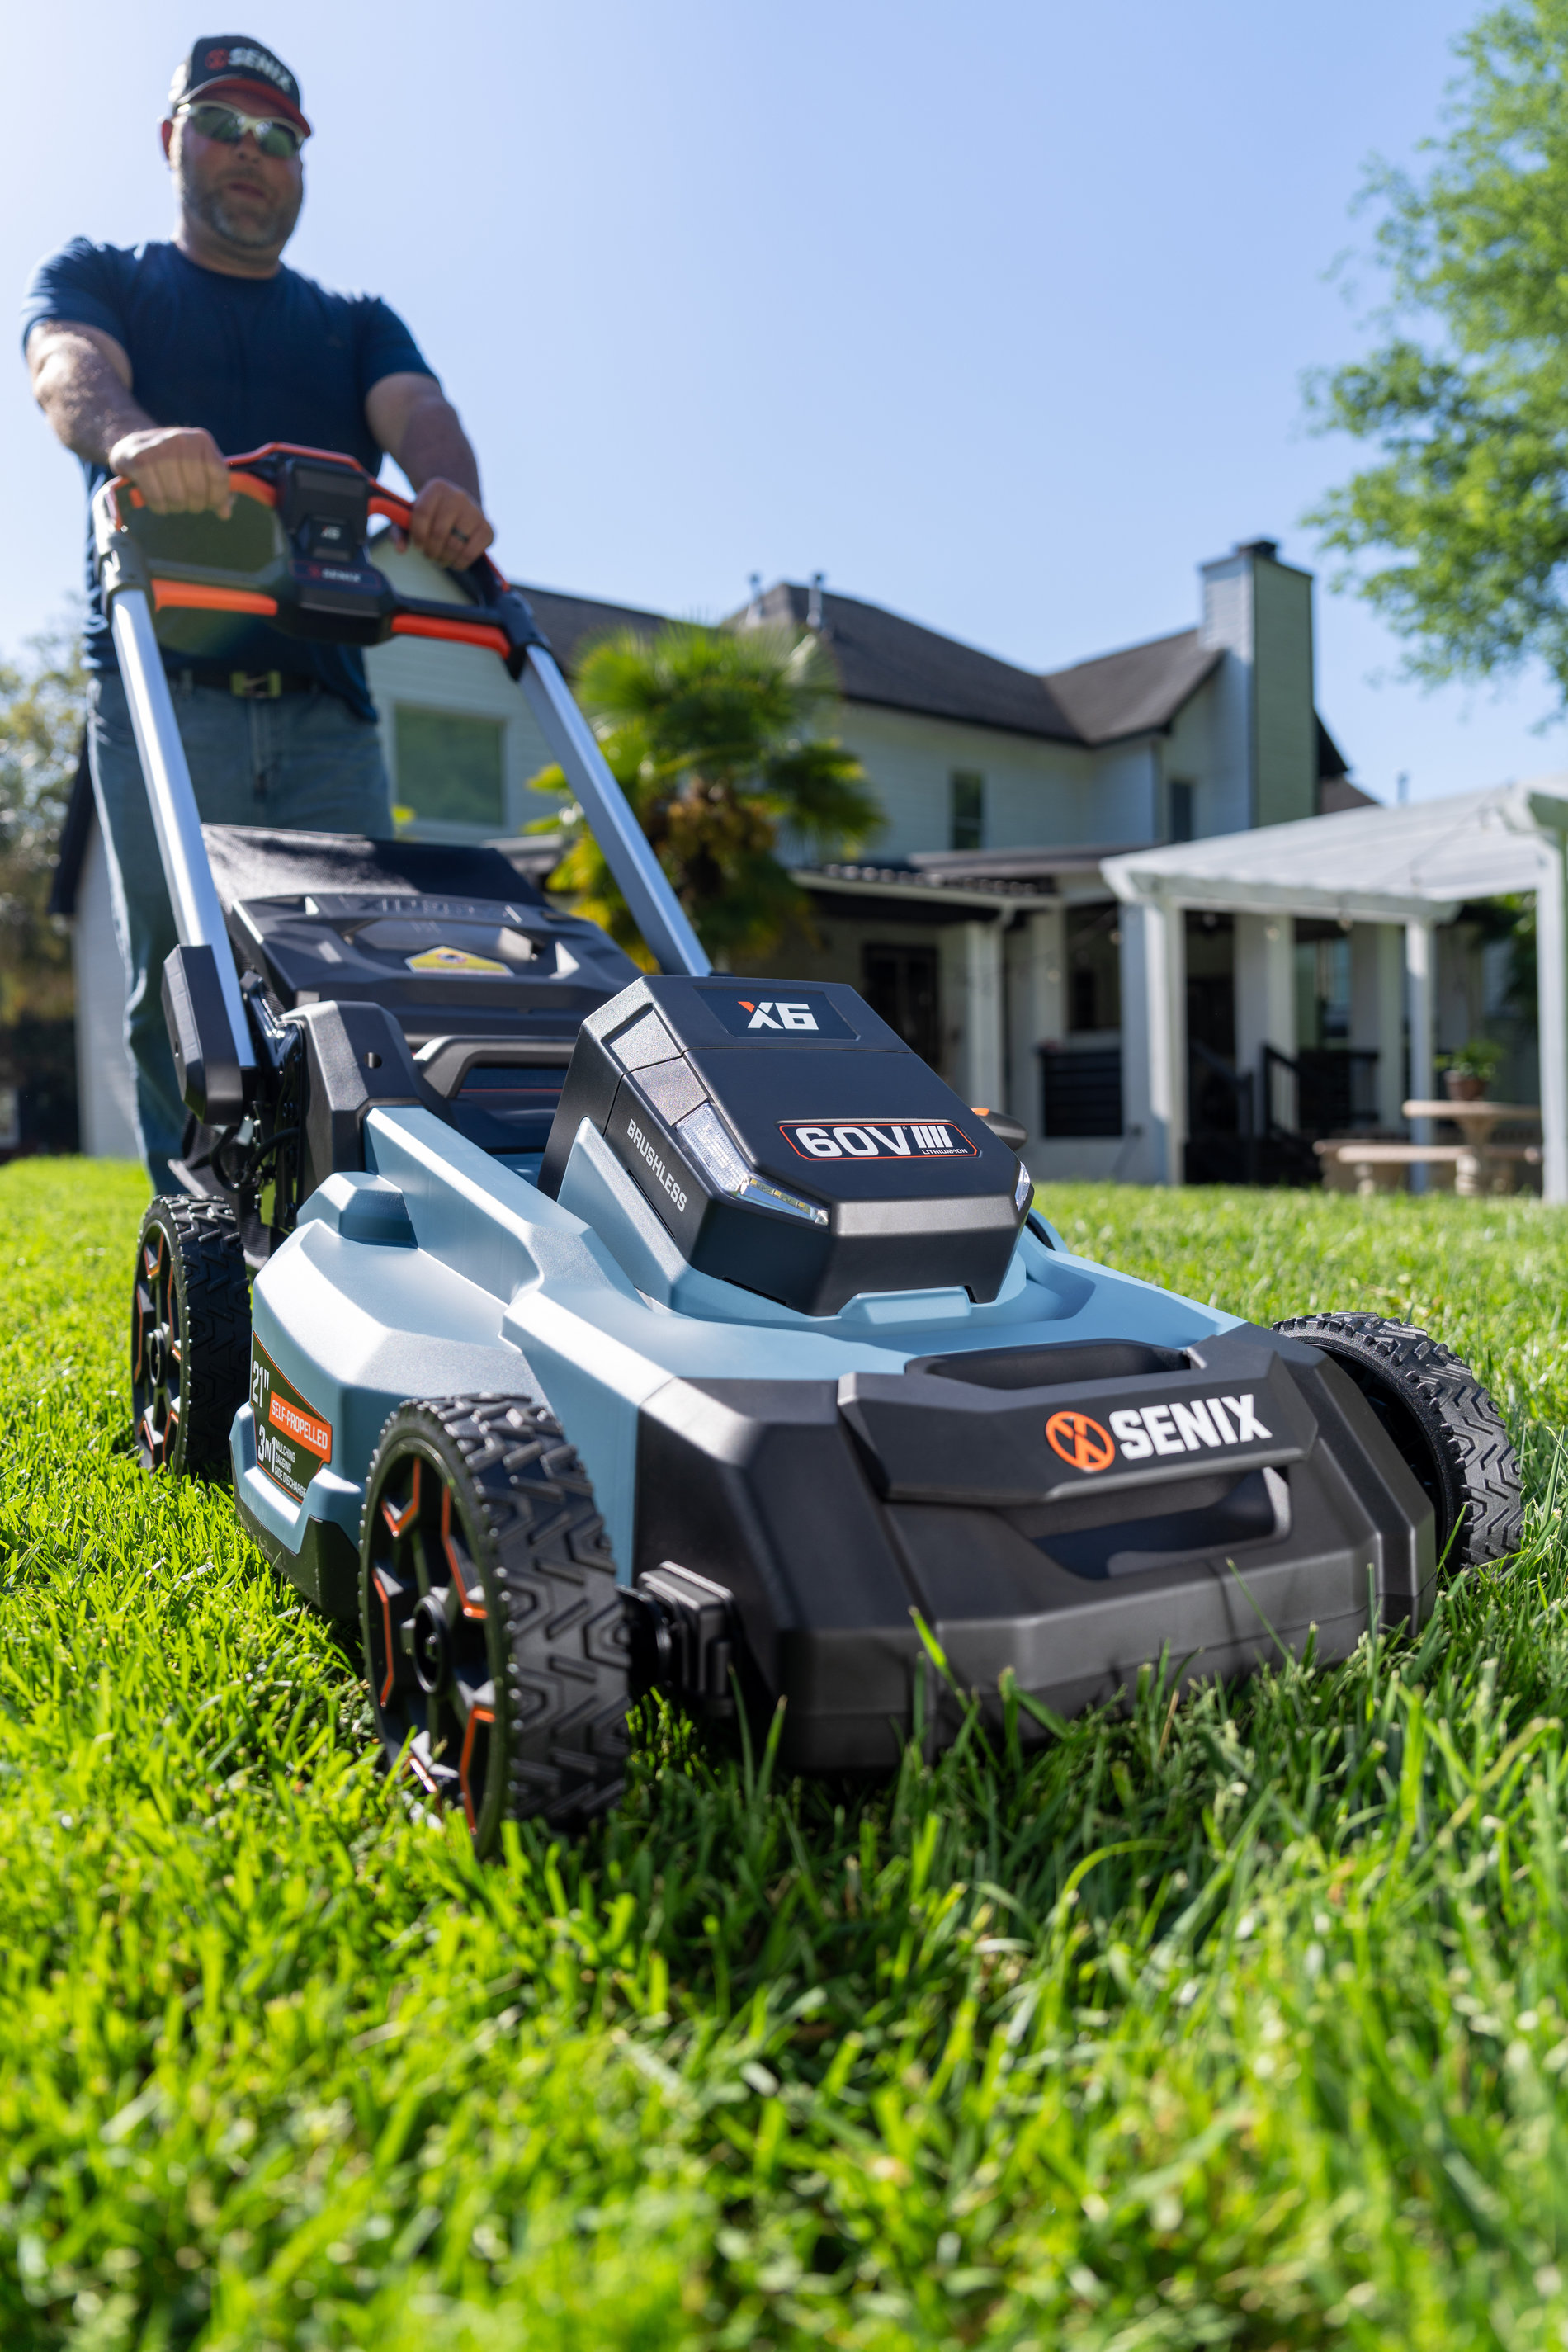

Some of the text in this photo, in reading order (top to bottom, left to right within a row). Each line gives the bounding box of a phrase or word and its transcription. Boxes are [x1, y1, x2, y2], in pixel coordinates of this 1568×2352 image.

[229, 47, 290, 92] SENIX
[737, 1001, 819, 1030] X6
[627, 1118, 687, 1212] BRUSHLESS
[272, 1400, 328, 1450] SELF-PROPELLED
[1108, 1394, 1273, 1460] SENIX
[275, 1452, 292, 1474] BAGGING
[276, 1439, 295, 1463] MULCHING
[274, 1465, 307, 1499] SIDE DISCHARGE
